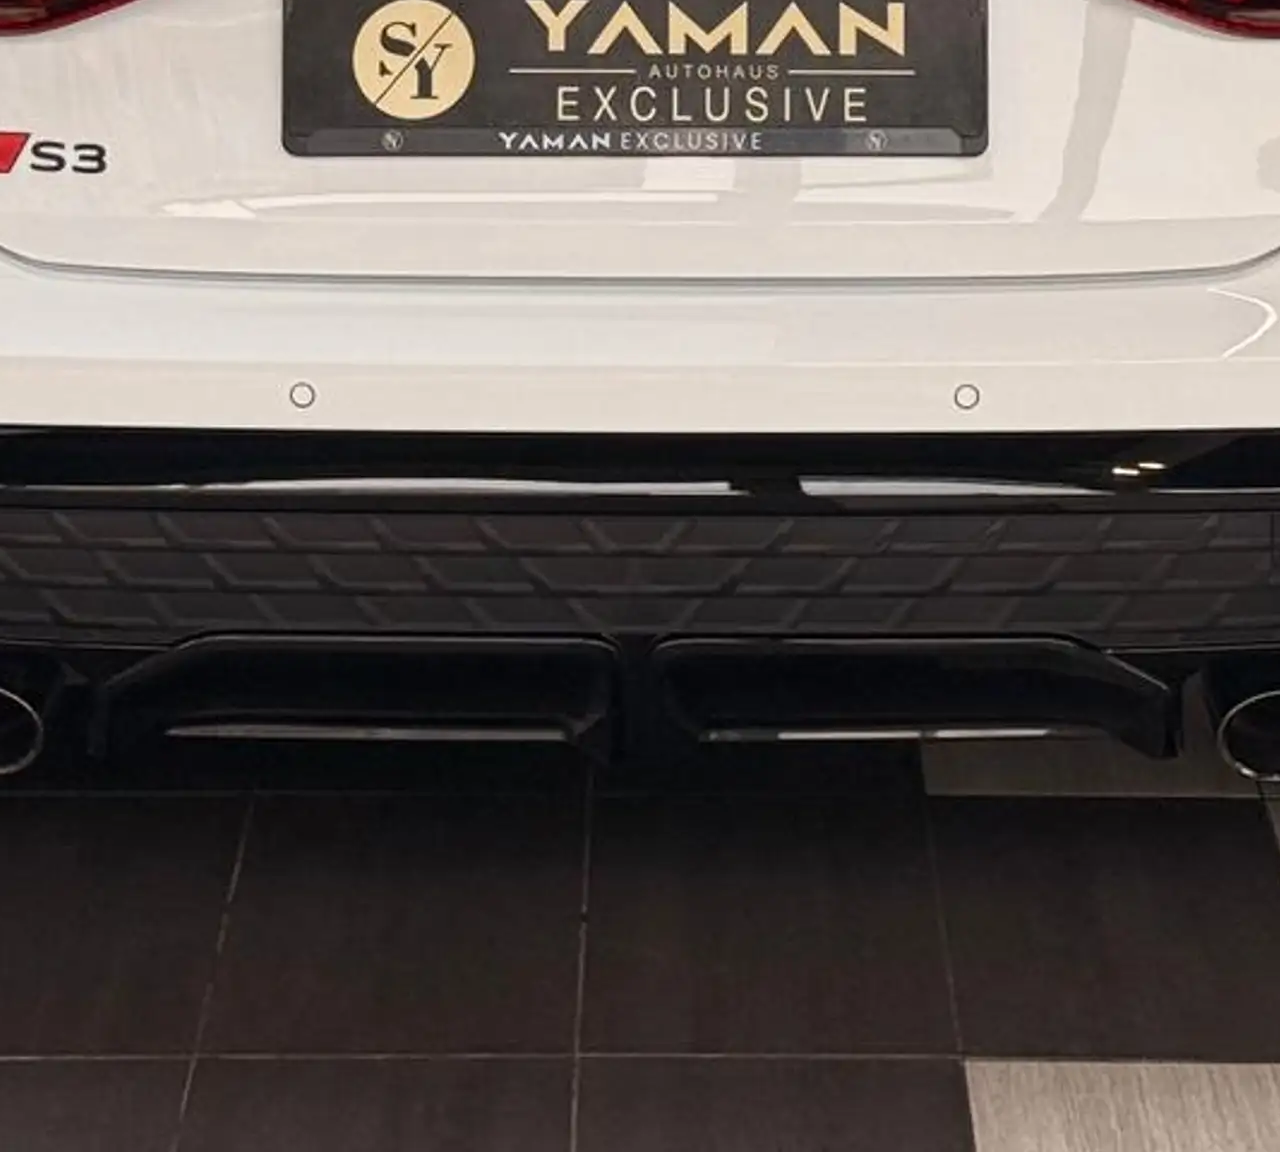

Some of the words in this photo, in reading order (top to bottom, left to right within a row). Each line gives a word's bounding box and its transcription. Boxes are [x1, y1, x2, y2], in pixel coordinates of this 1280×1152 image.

[647, 64, 780, 80] AUTOHAUS
[556, 85, 868, 123] EXCLUSIVE
[498, 131, 611, 150] YAMAN
[619, 131, 763, 151] EXCLUSIVE
[29, 140, 107, 173] S3
